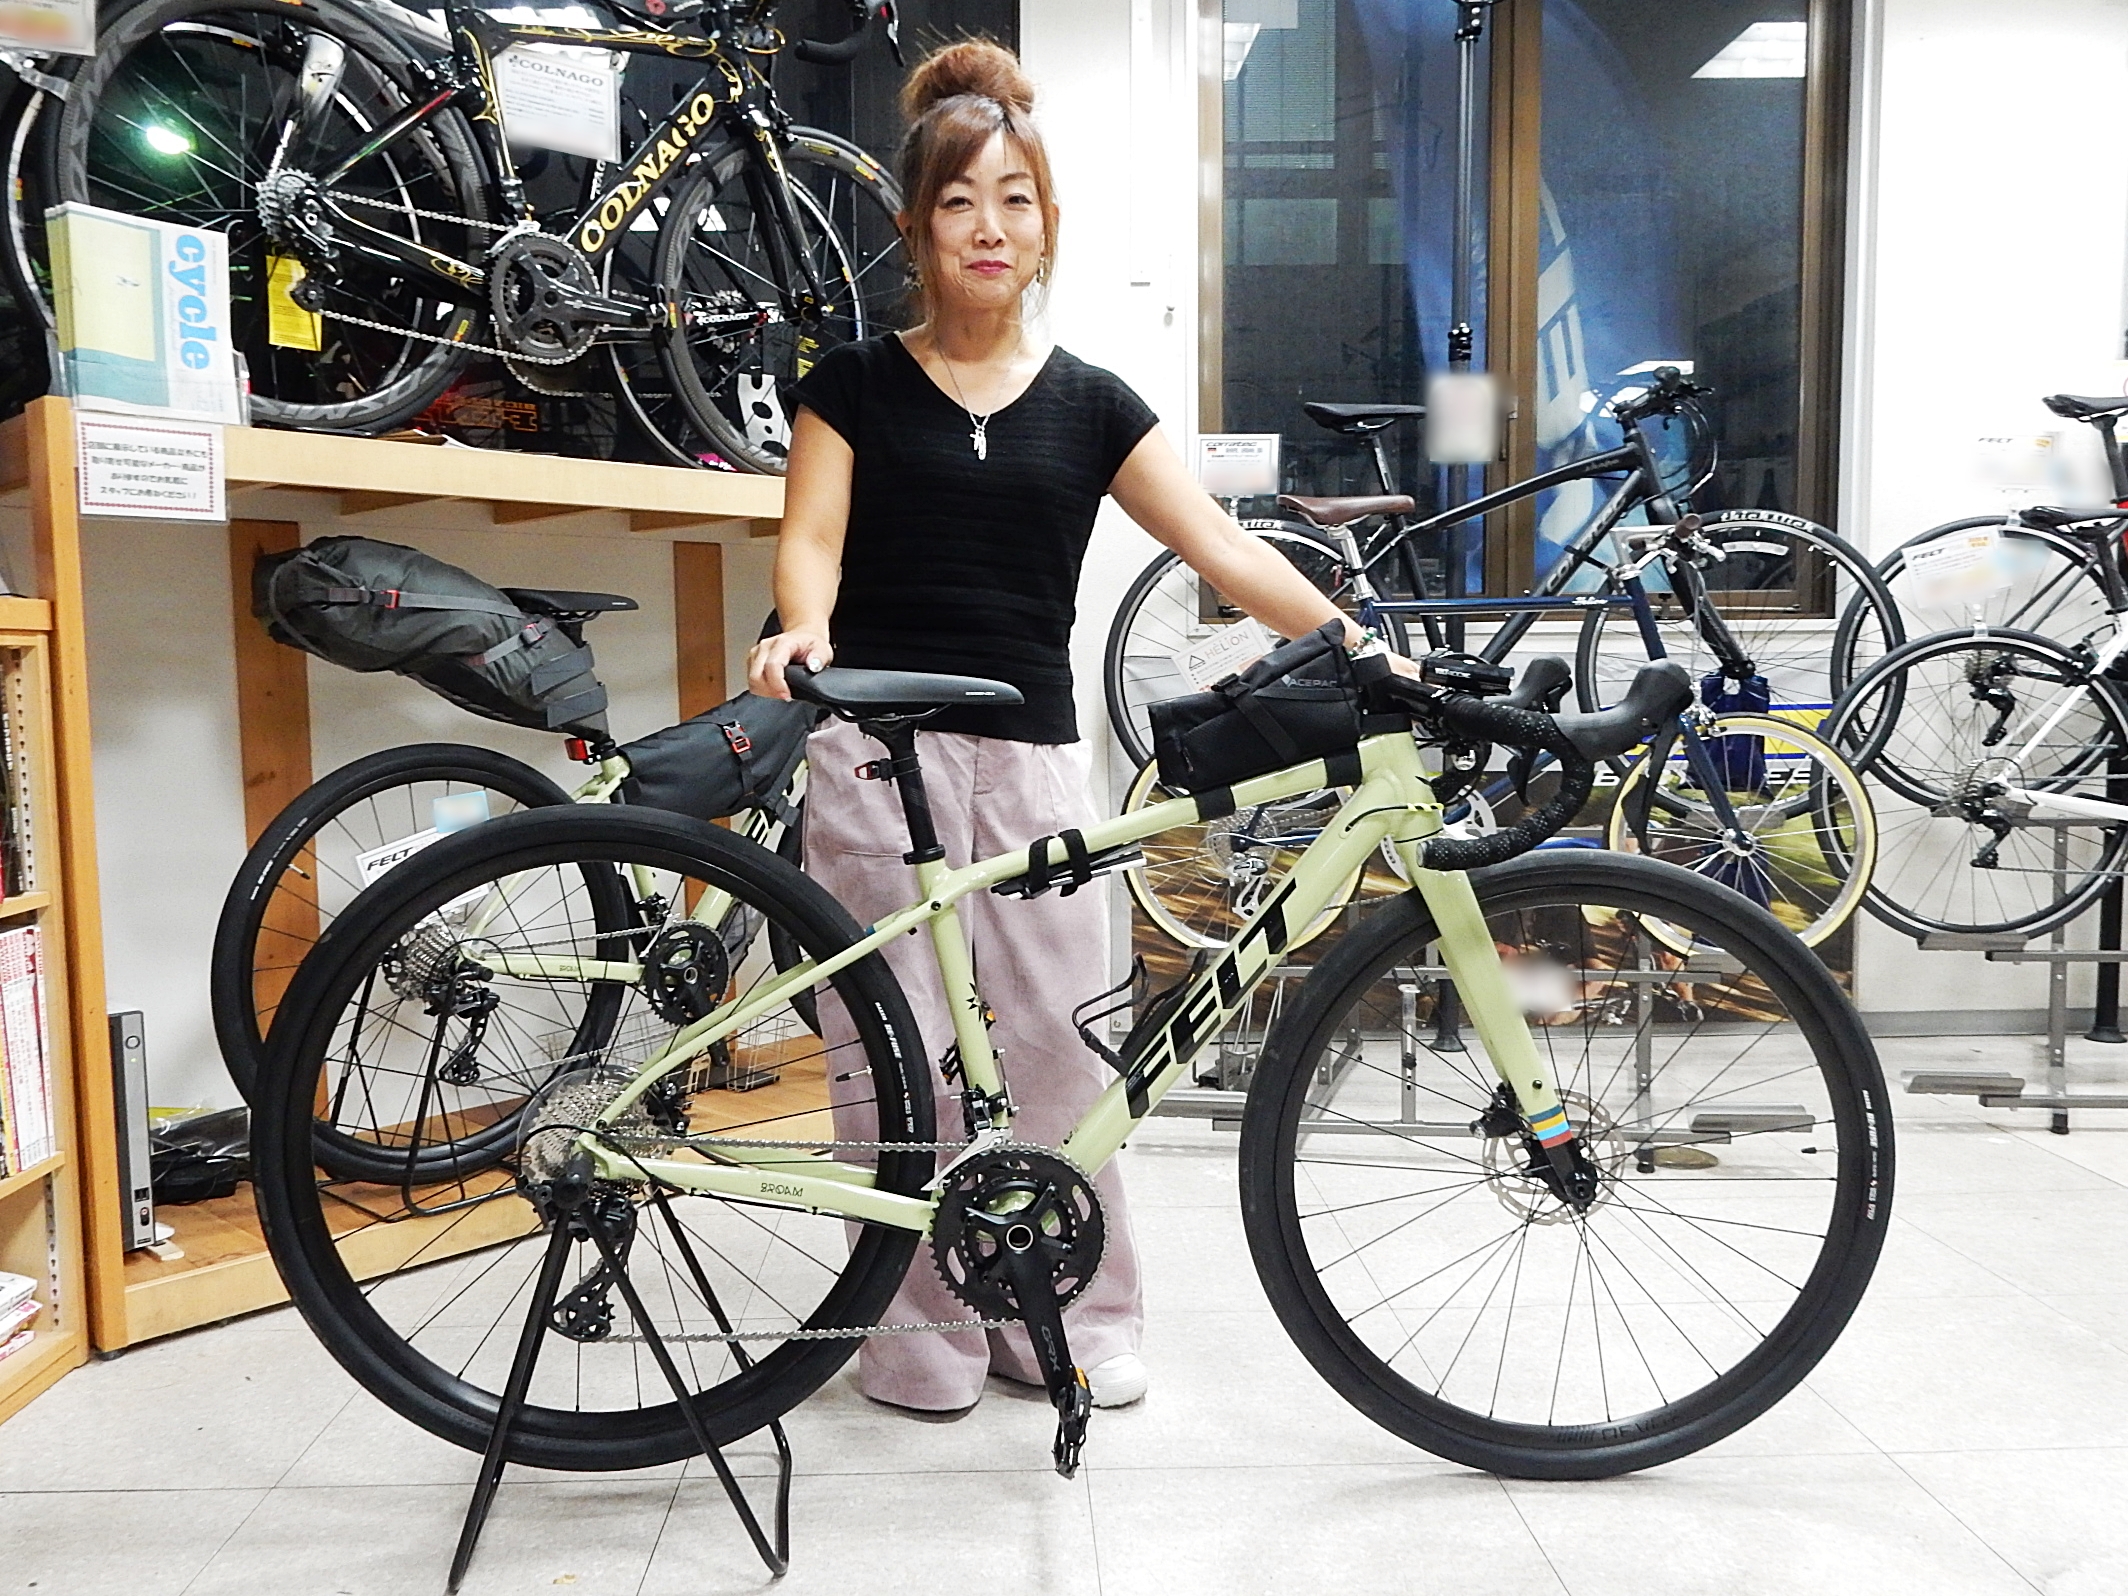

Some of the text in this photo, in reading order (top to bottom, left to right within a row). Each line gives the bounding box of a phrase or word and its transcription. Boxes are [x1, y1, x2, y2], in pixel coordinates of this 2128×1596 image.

[519, 59, 604, 87] COLNAGO
[581, 93, 714, 252] COLNAGO
[168, 234, 217, 370] cycle
[1547, 495, 1627, 593] coratec
[367, 847, 413, 871] FELT
[1125, 877, 1298, 1119] FELT
[760, 1182, 804, 1197] BROAM
[1041, 1325, 1061, 1372] GRX
